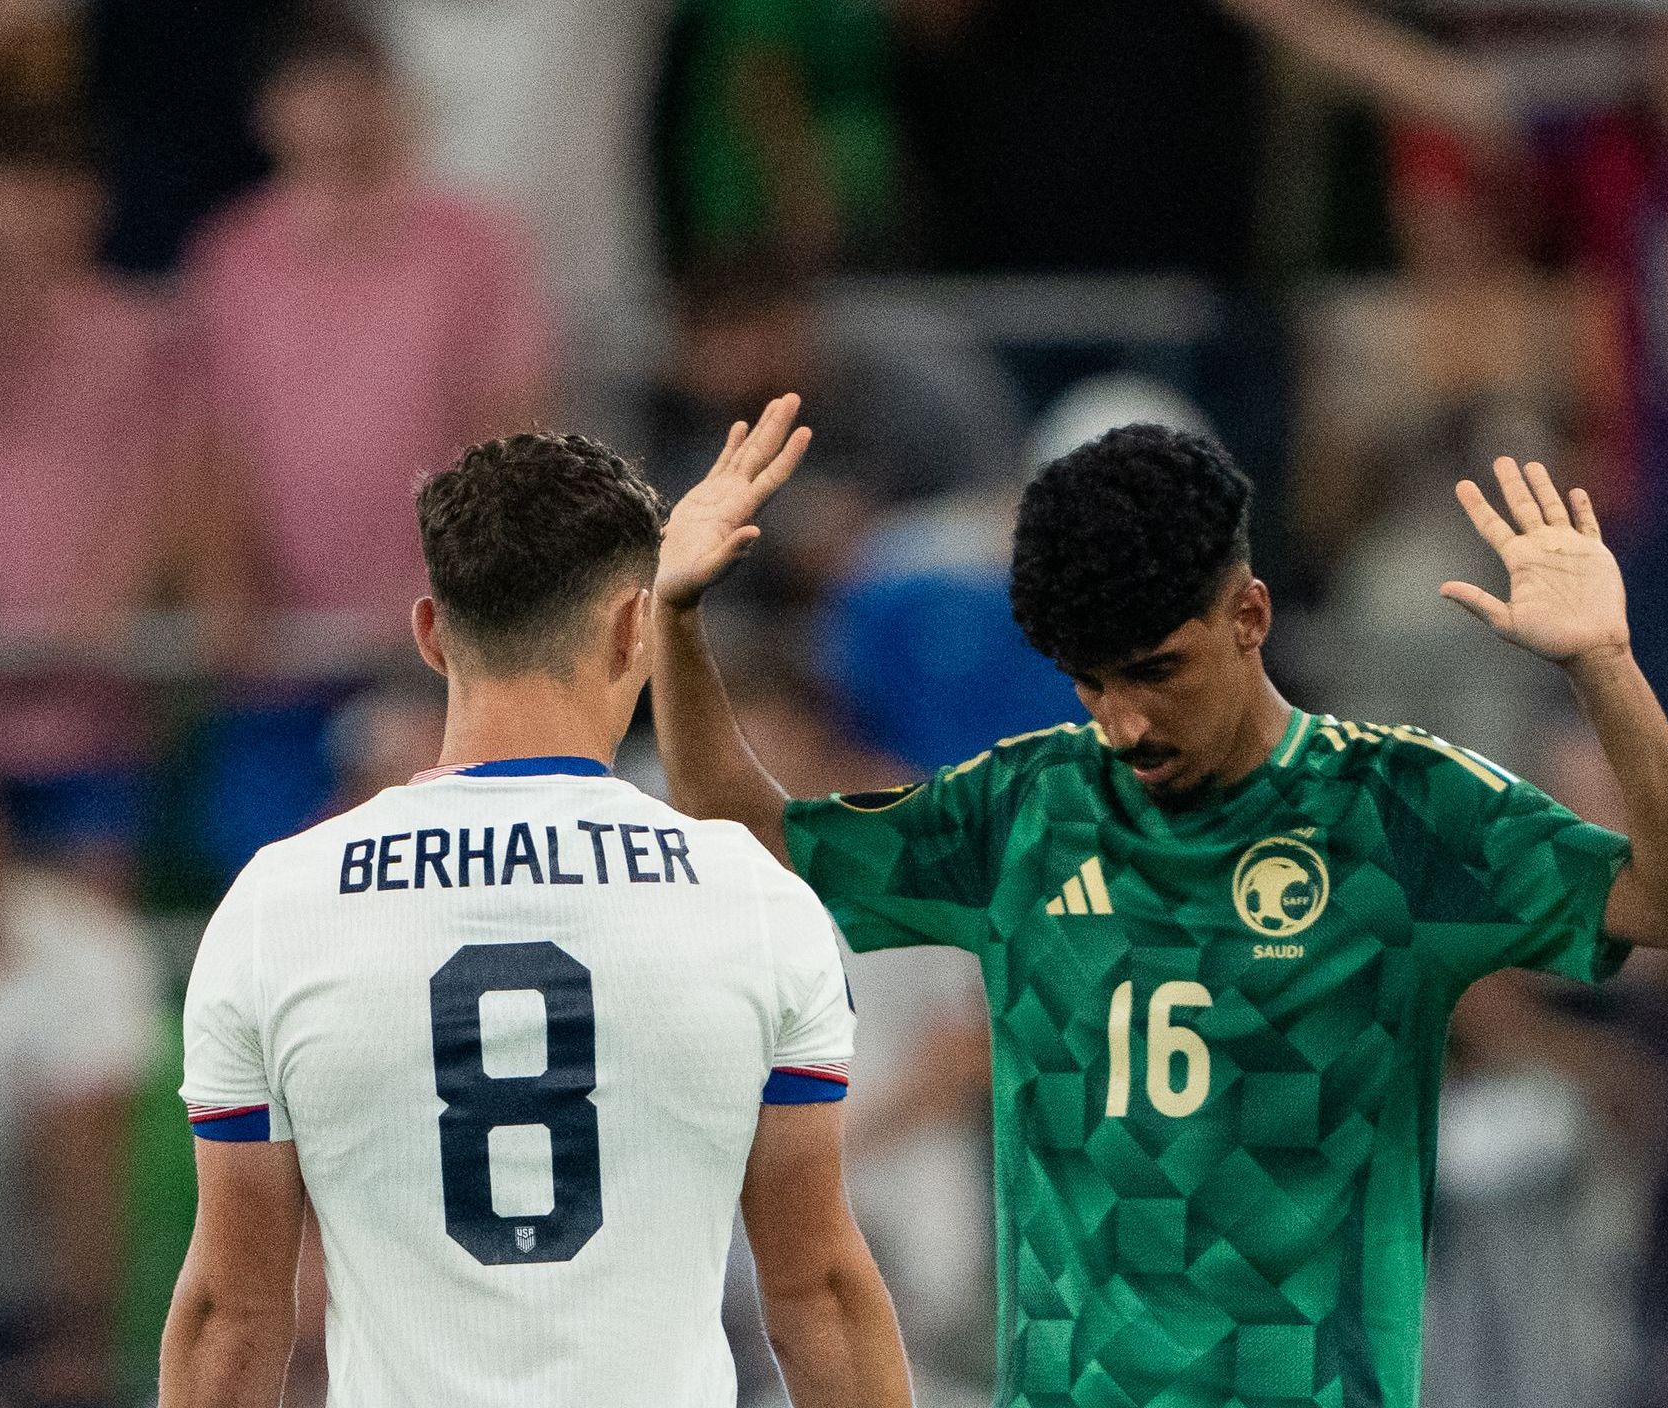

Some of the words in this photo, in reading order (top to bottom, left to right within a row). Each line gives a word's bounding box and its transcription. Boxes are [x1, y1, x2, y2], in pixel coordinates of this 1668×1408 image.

[338, 819, 700, 894] BERHALTER
[1282, 896, 1309, 906] SAFF
[1252, 944, 1306, 960] SAUDI
[1105, 979, 1213, 1119] 16
[429, 940, 604, 1266] 8
[516, 1227, 535, 1239] USA
